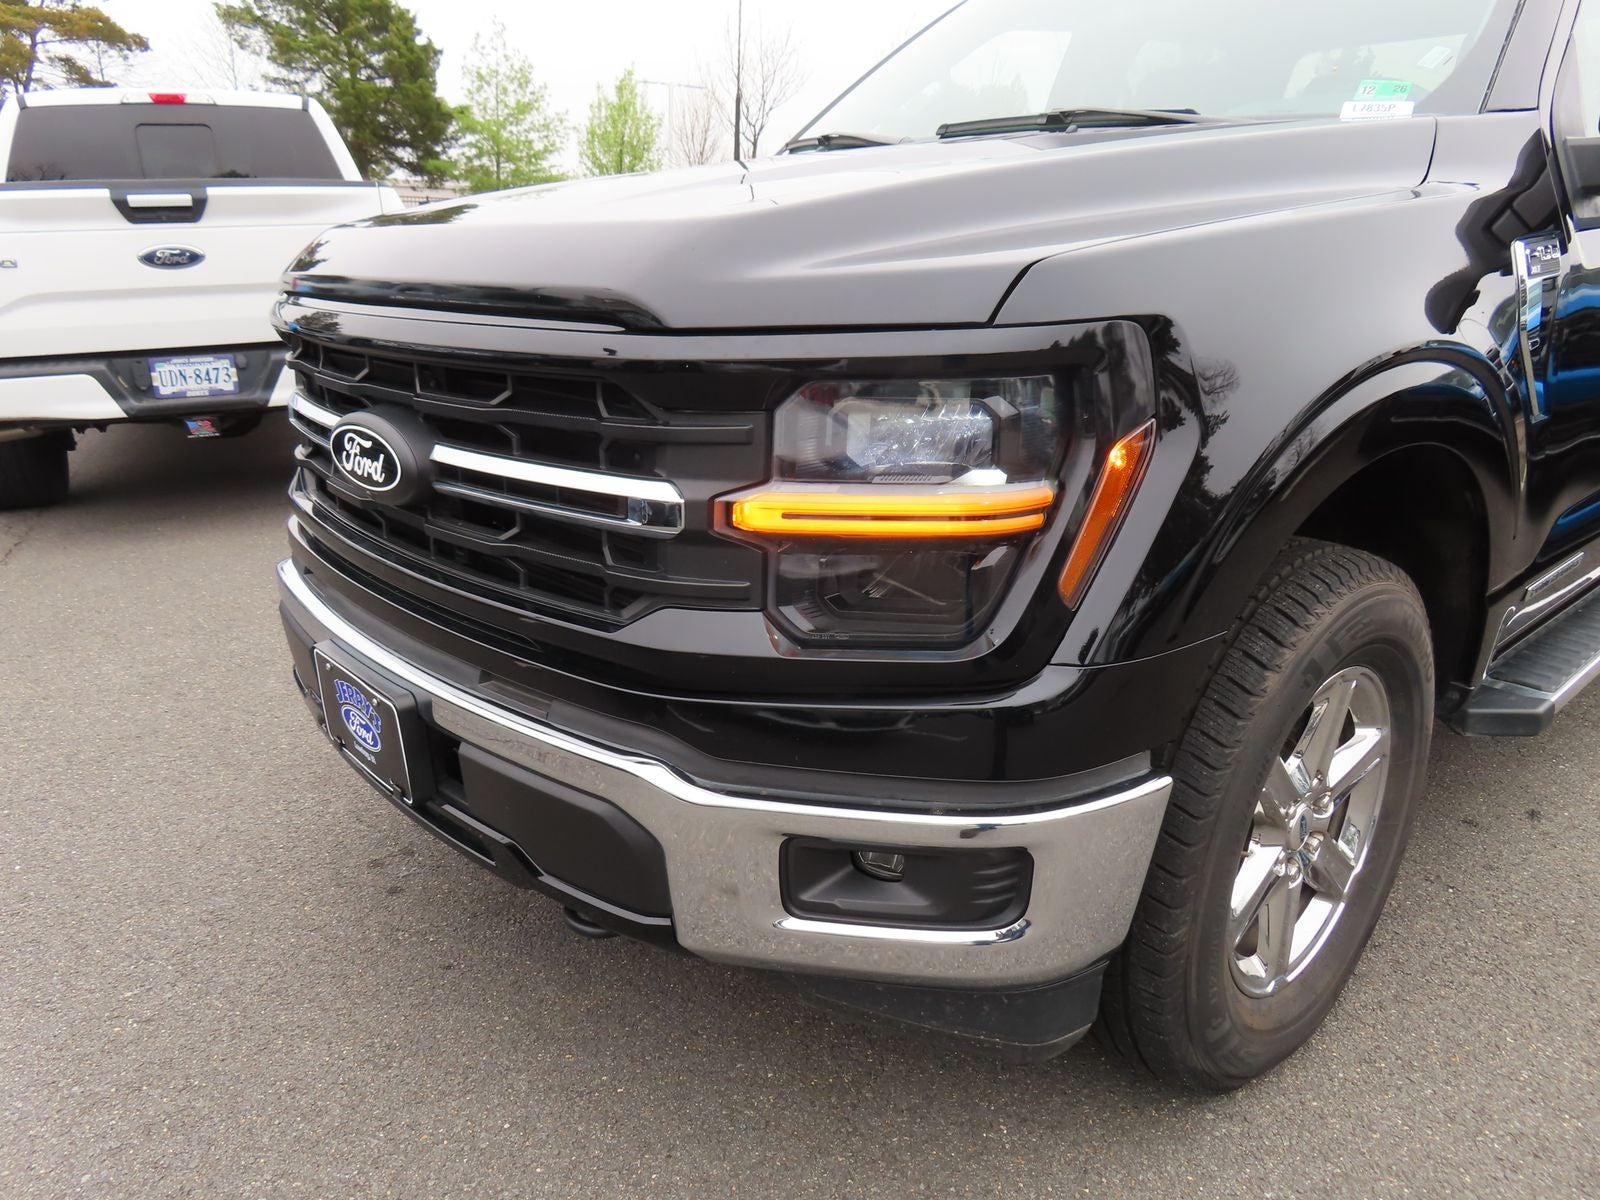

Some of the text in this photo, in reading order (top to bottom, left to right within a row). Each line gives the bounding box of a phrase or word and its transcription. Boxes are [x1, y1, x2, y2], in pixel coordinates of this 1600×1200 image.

[1361, 86, 1377, 95] 12
[154, 249, 190, 265] Ford
[158, 366, 232, 387] UDN-8473
[342, 432, 386, 483] Ford
[334, 679, 382, 733] JERRY'S
[348, 710, 374, 745] Ford
